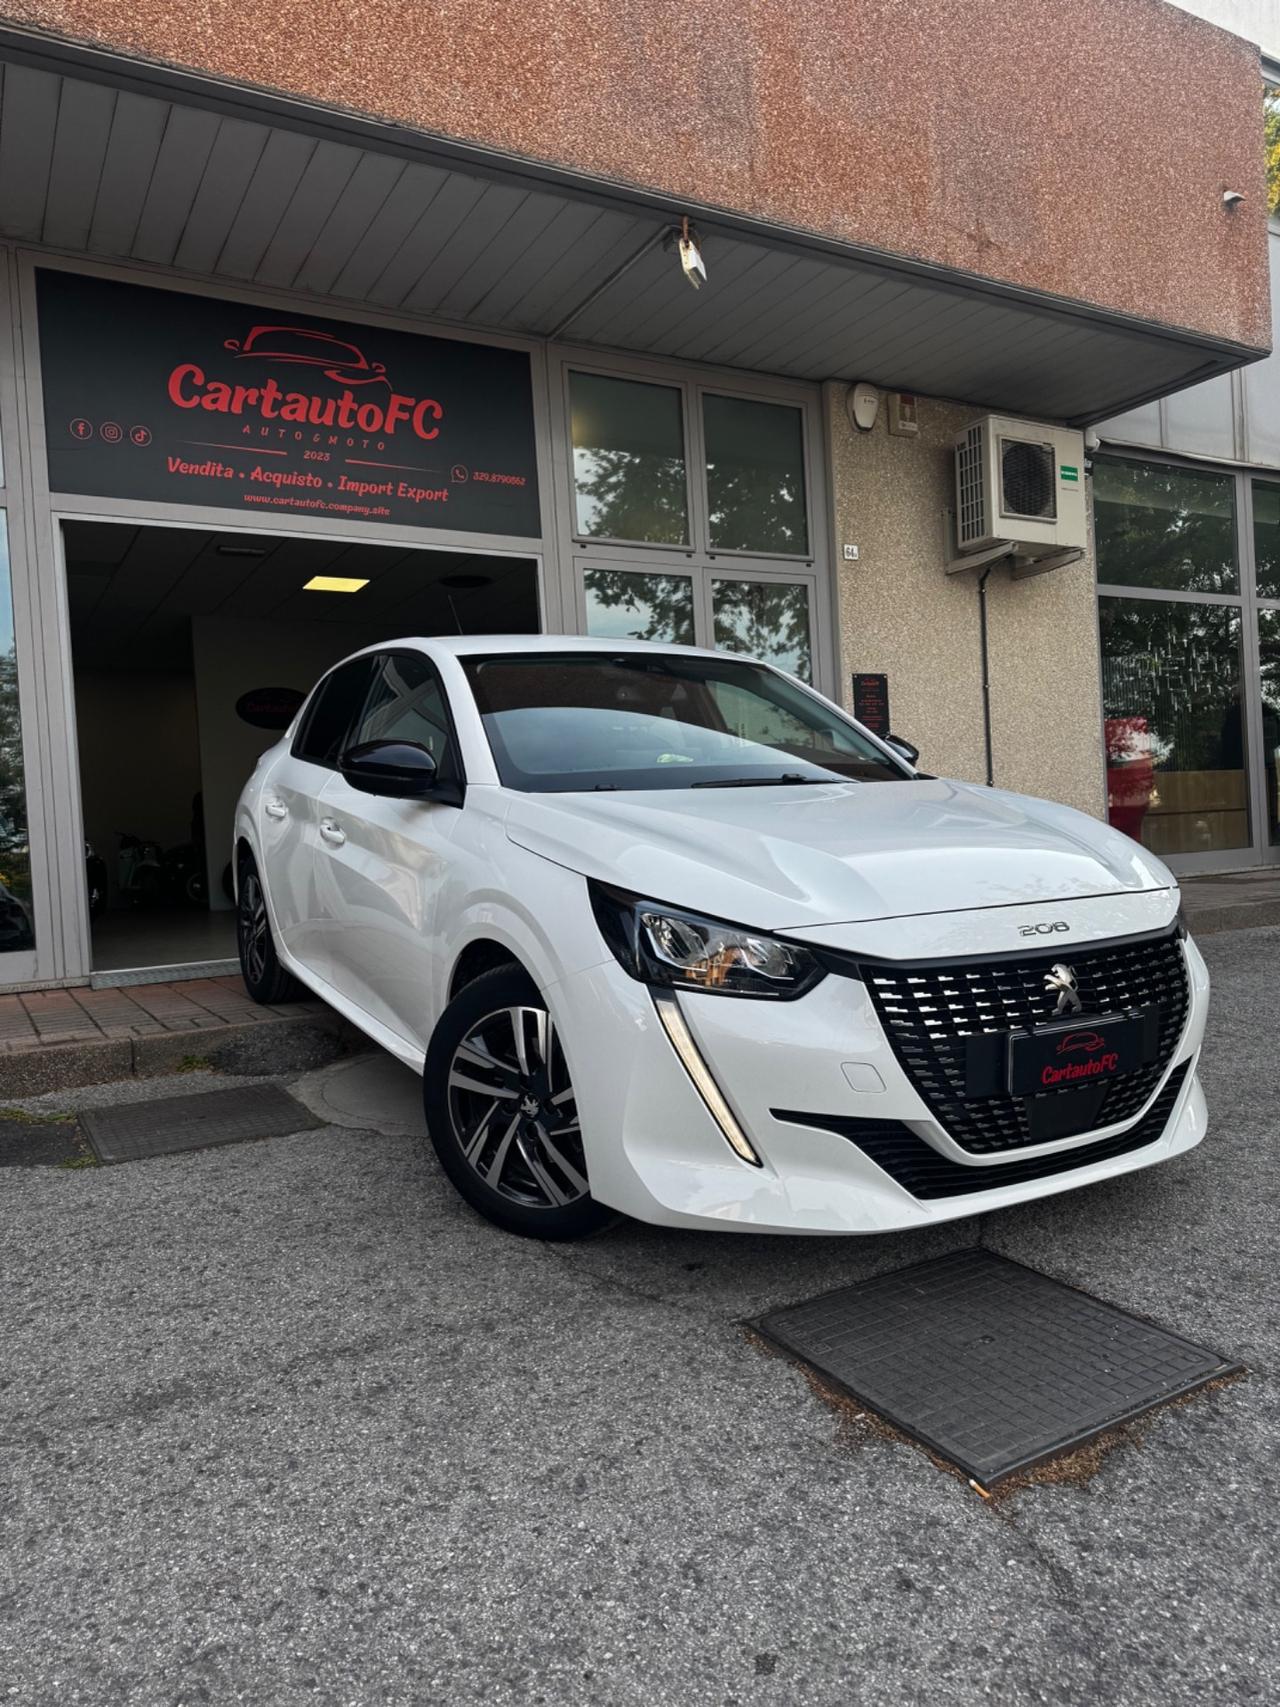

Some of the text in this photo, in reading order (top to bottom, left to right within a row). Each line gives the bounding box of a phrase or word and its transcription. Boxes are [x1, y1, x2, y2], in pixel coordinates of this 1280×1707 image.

[168, 363, 443, 440] CartautoFC
[304, 450, 331, 462] 2023
[167, 456, 449, 503] Vendita Acquisto Import Export
[244, 494, 391, 516] www.cartautofc.company.site
[1018, 921, 1070, 937] 208
[1041, 1052, 1118, 1084] CartautoFC
